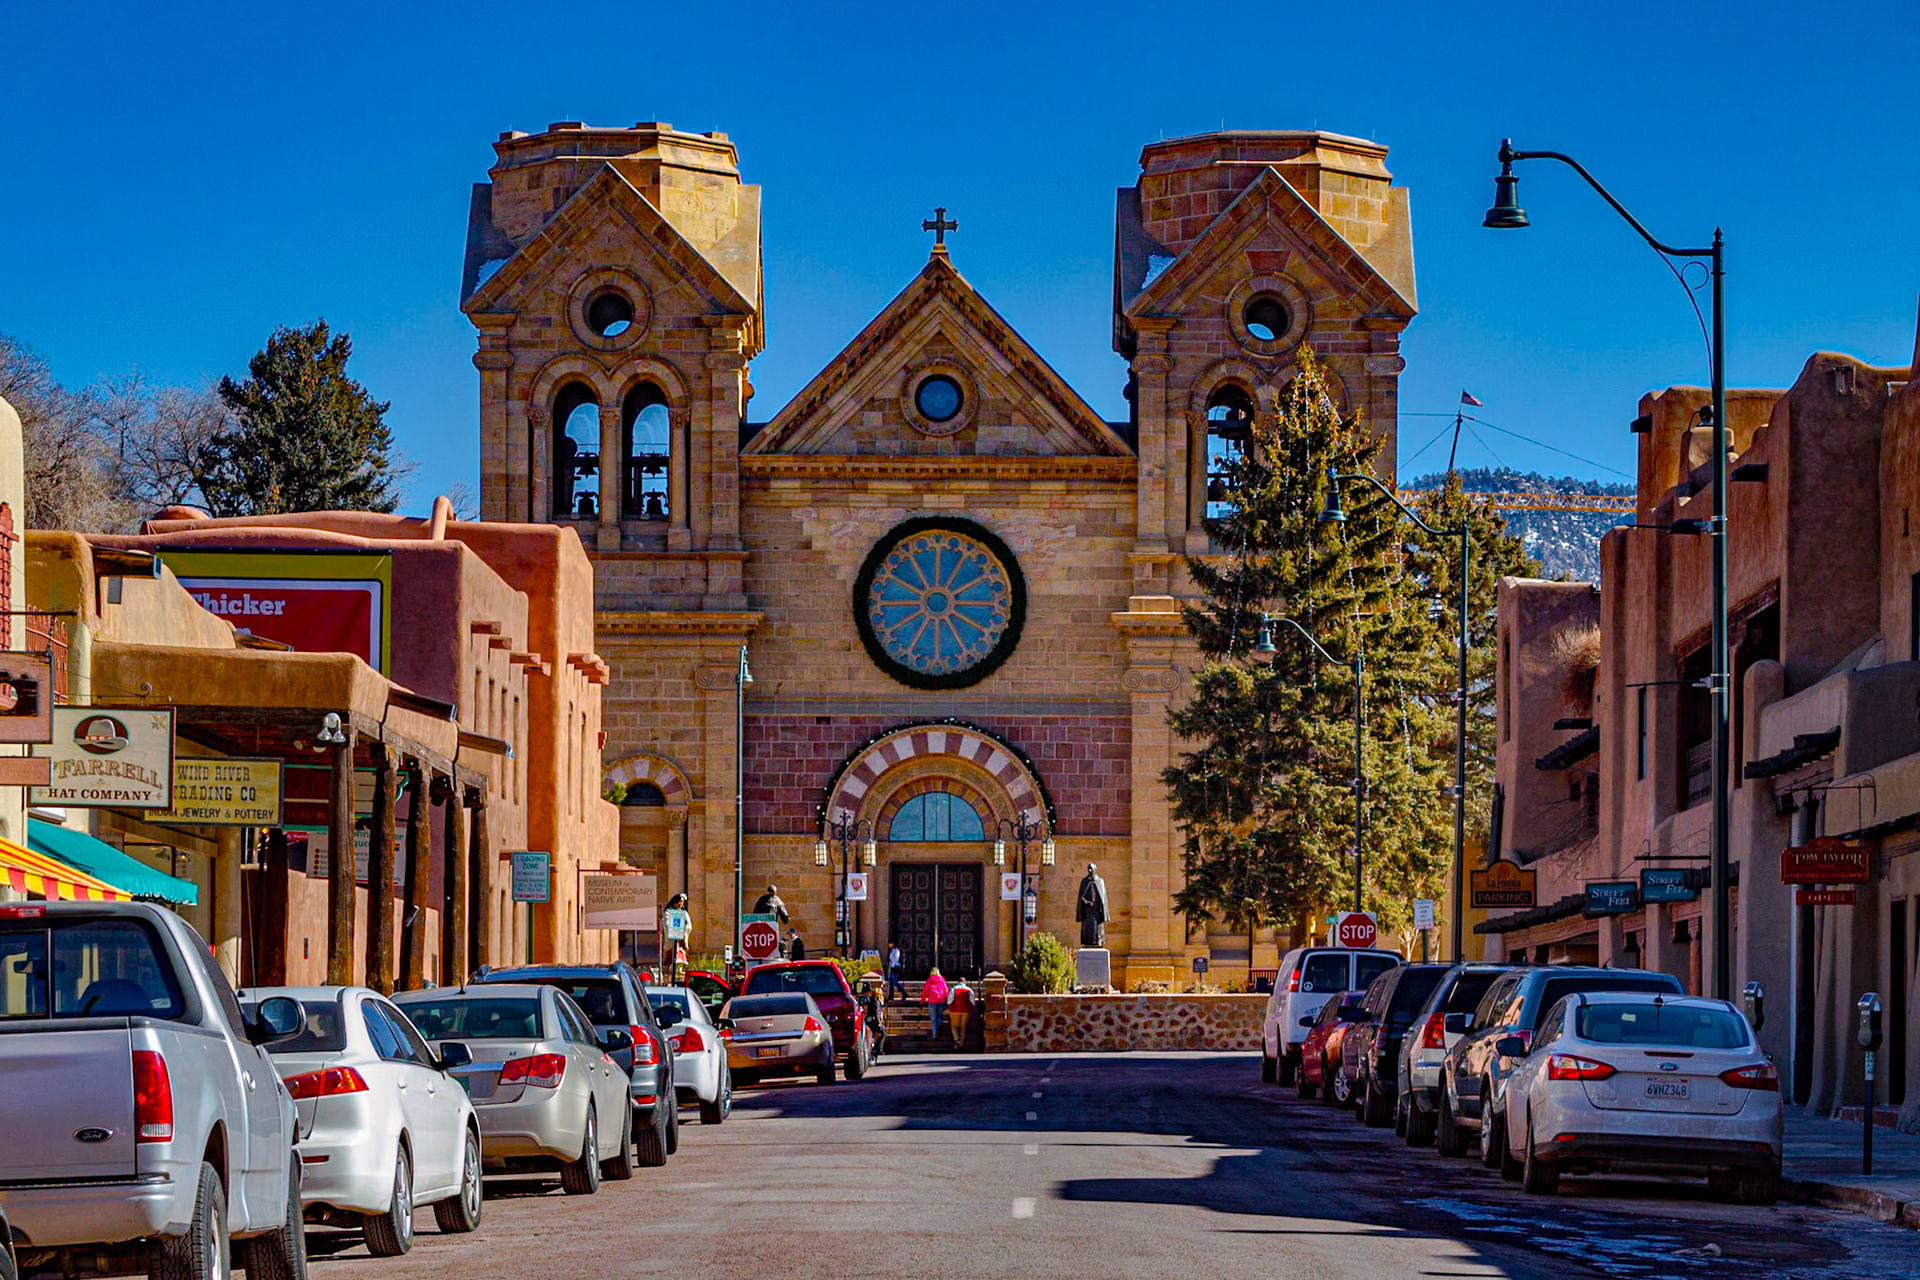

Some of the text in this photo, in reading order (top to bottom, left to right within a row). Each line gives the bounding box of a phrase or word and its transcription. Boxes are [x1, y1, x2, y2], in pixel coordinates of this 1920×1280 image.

[53, 759, 162, 789] 'FARRELL
[177, 765, 251, 781] WIND RIVER
[48, 788, 151, 800] HAT COMPANY
[241, 786, 256, 801] CO
[180, 808, 221, 818] JEWELRY
[225, 809, 231, 818] &
[234, 809, 274, 819] POTTERY
[522, 862, 539, 870] ZONE
[1792, 852, 1866, 868] TOM TAYLOR
[1486, 876, 1496, 888] La
[1647, 875, 1680, 884] STREET
[1478, 892, 1529, 902] PARKING
[1592, 888, 1624, 898] STREET
[588, 896, 615, 904] NATIVE
[1608, 896, 1630, 906] FEET
[1342, 925, 1374, 939] STOP
[745, 933, 775, 947] STOP
[1647, 1084, 1687, 1096] 6VHZ348
